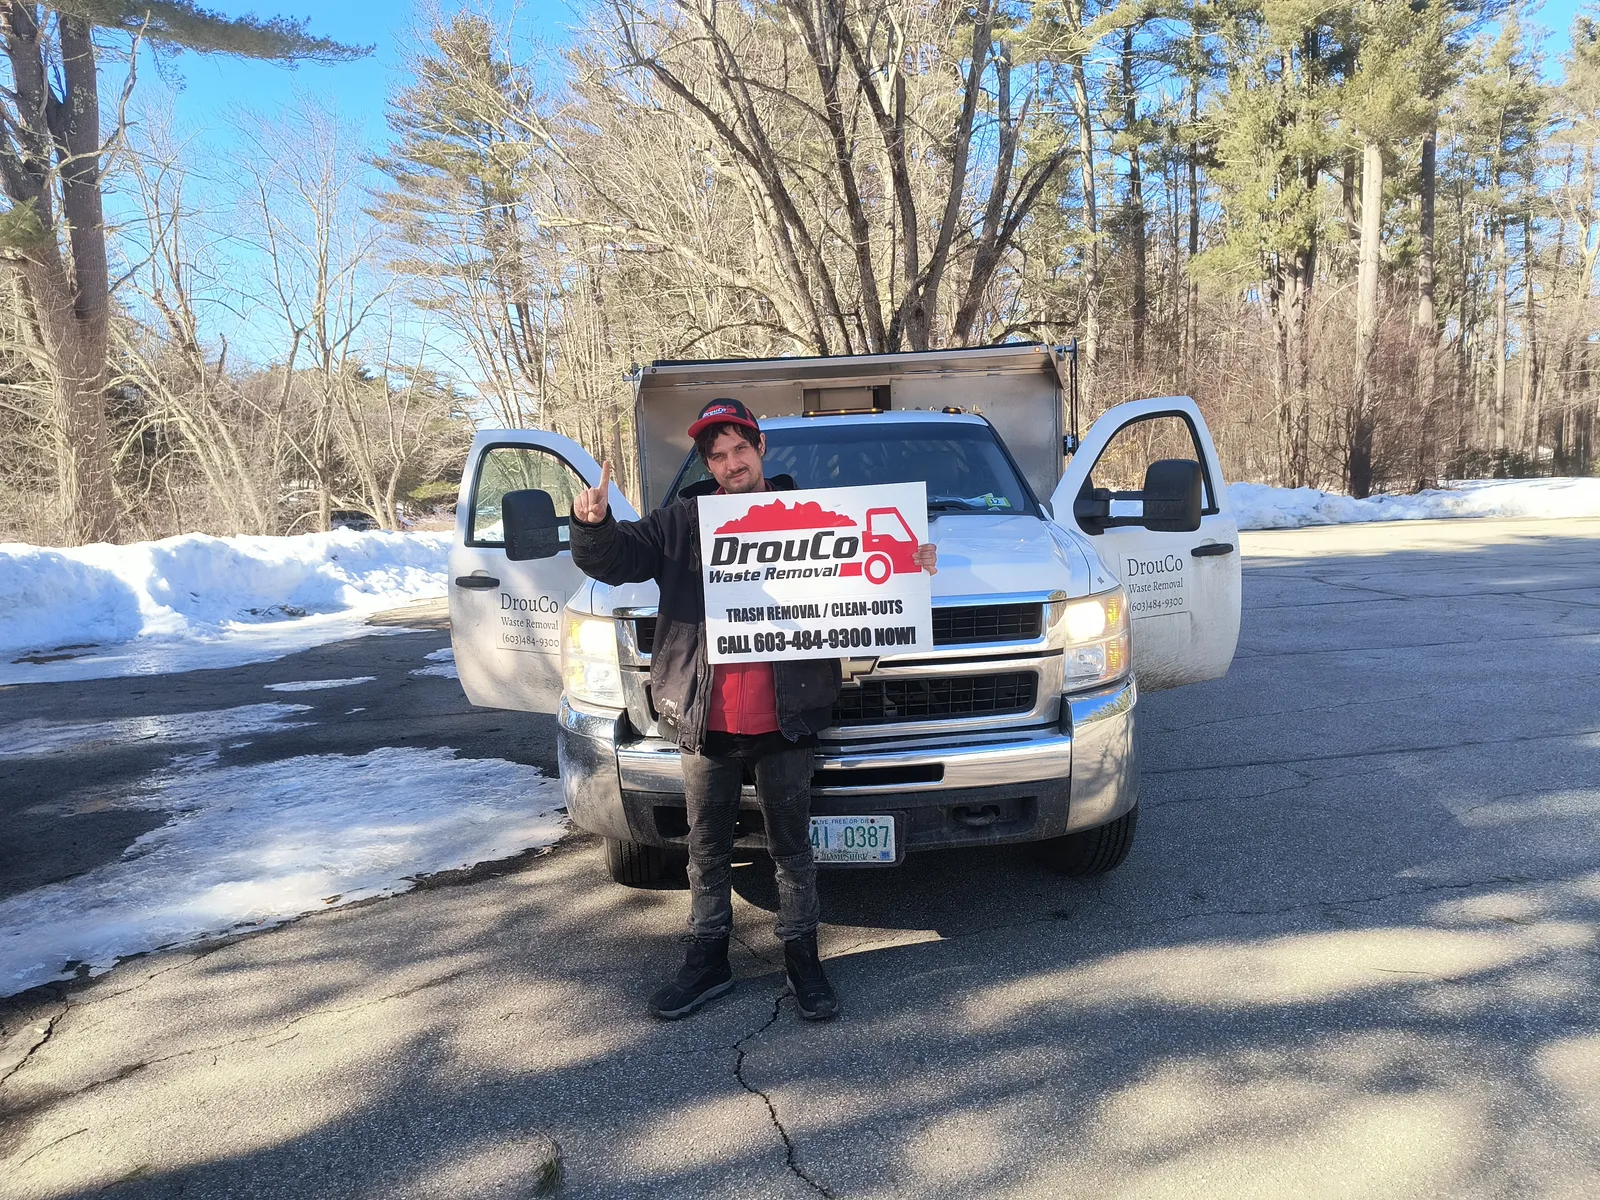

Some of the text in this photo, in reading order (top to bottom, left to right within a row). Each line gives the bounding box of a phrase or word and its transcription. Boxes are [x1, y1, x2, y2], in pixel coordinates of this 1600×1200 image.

[709, 530, 859, 567] DrouCo
[709, 564, 839, 584] Waste Removal
[1127, 554, 1183, 577] DrouCo
[1128, 577, 1184, 594] Waste Removal
[500, 592, 559, 614] DrouCo
[726, 599, 903, 623] TRASH REMOVAL / CLEAN-OUTS
[1129, 597, 1184, 614] (603)484-9300
[501, 616, 559, 631] Waste Removal
[502, 632, 560, 648] (603)484-9300
[717, 626, 917, 655] CALL 603-484-9300 NOW!
[811, 825, 889, 848] 41 0387
